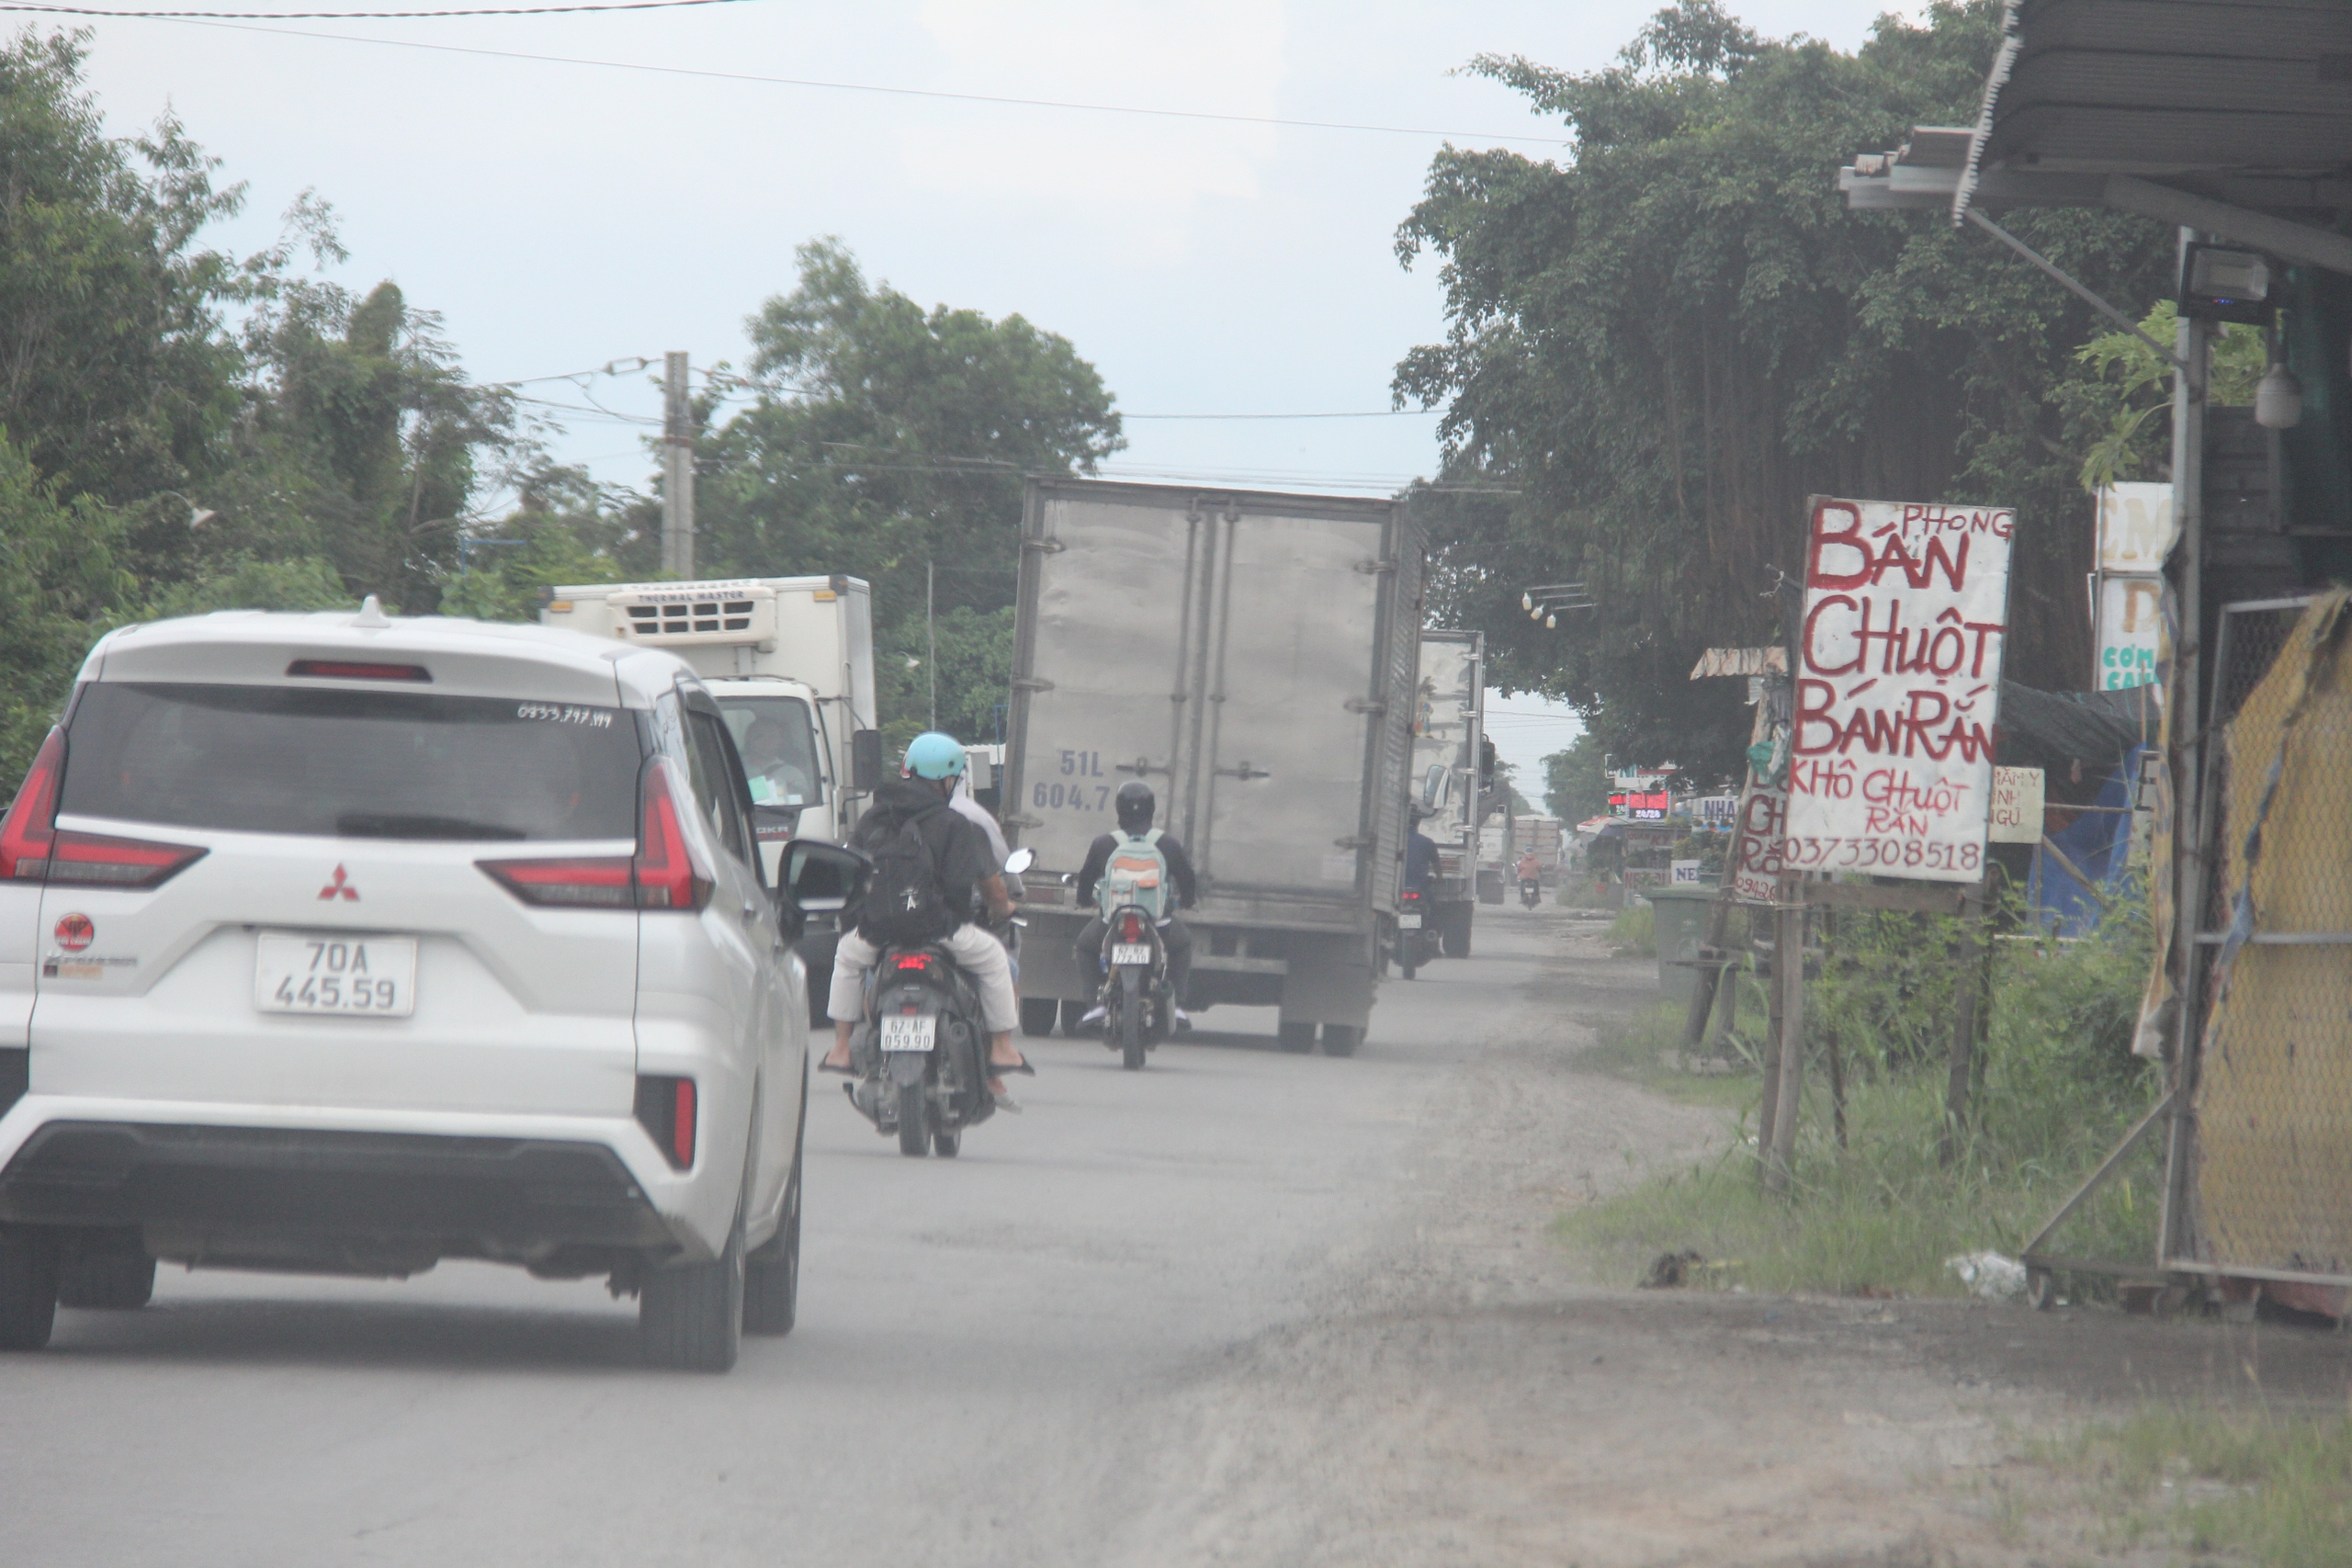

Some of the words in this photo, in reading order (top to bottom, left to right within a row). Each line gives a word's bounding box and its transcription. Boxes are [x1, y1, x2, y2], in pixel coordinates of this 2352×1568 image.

[1807, 501, 1971, 592] BÁN
[696, 591, 745, 600] MASTER
[1792, 678, 1904, 756] BÁN
[1902, 684, 1998, 764] RẮN
[1060, 750, 1104, 777] 51L
[1788, 758, 1858, 798] KHÔ
[1784, 838, 1980, 871] 0373308518
[306, 942, 368, 973] 70A
[275, 976, 395, 1010] 445.59
